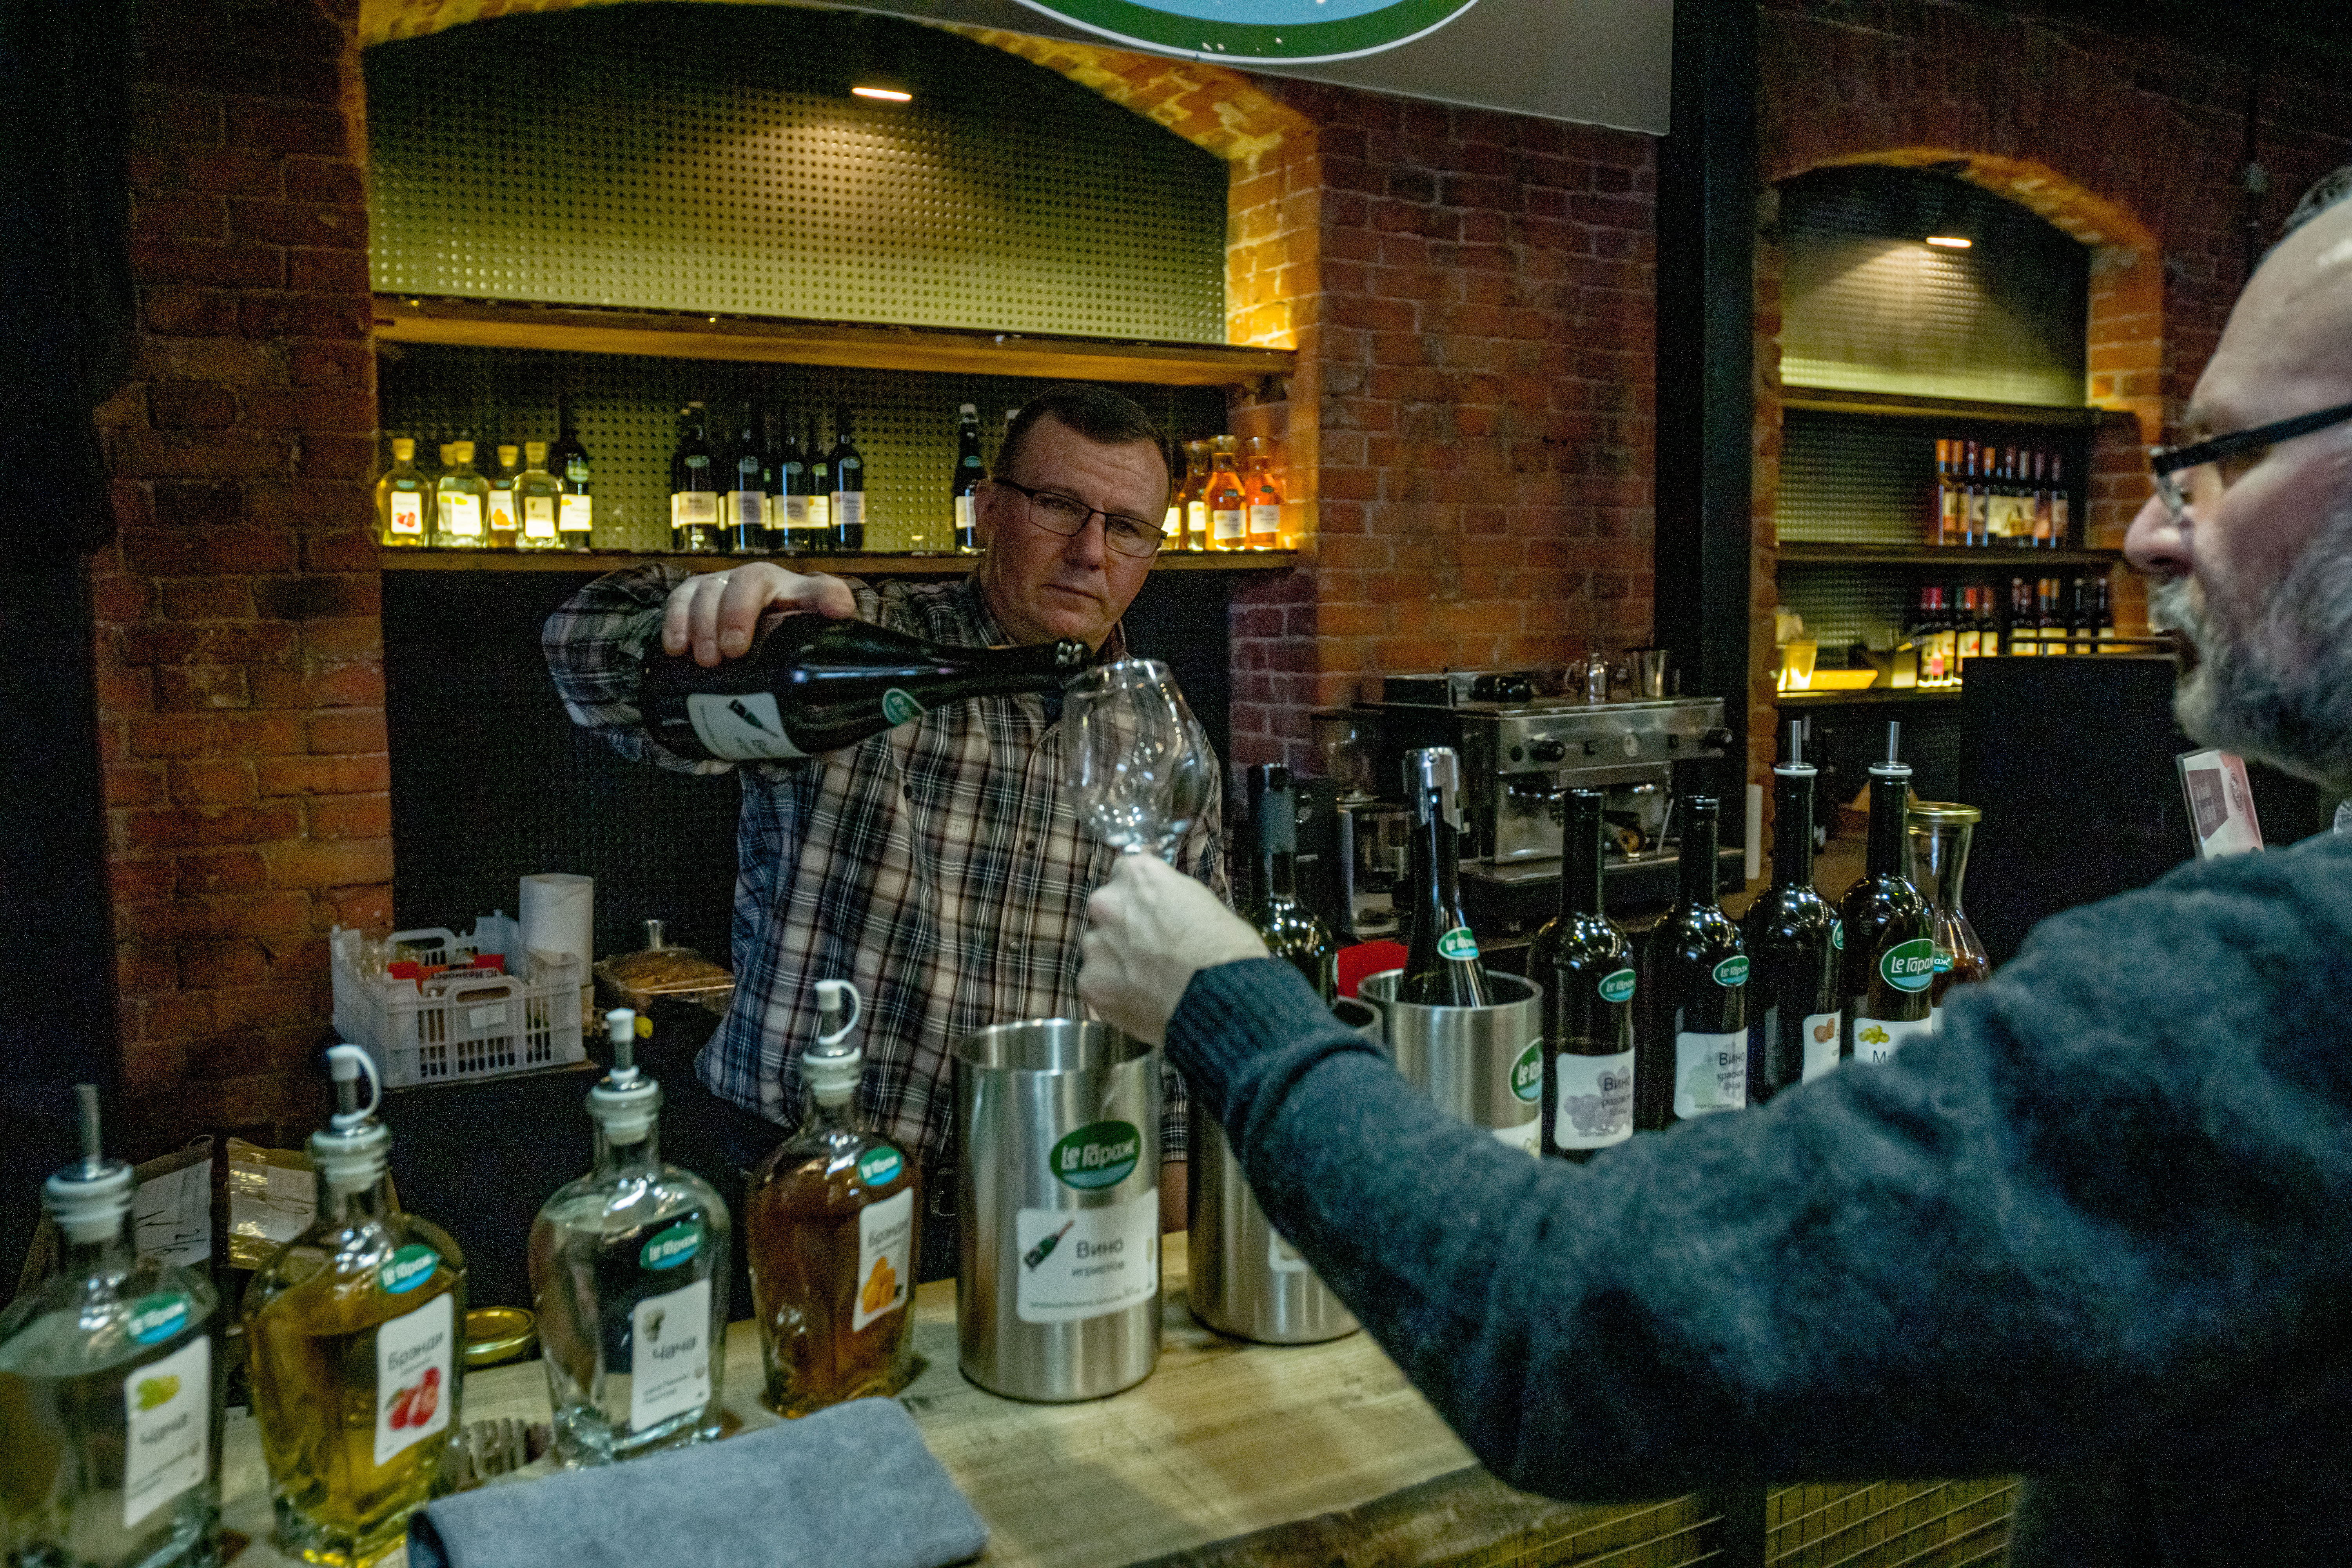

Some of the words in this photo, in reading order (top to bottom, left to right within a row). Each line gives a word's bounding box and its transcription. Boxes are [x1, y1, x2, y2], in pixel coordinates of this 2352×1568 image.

[1720, 967, 1729, 977] Le
[1891, 956, 1905, 973] Le
[1061, 1144, 1081, 1170] Le
[1076, 1238, 1123, 1258] Вино
